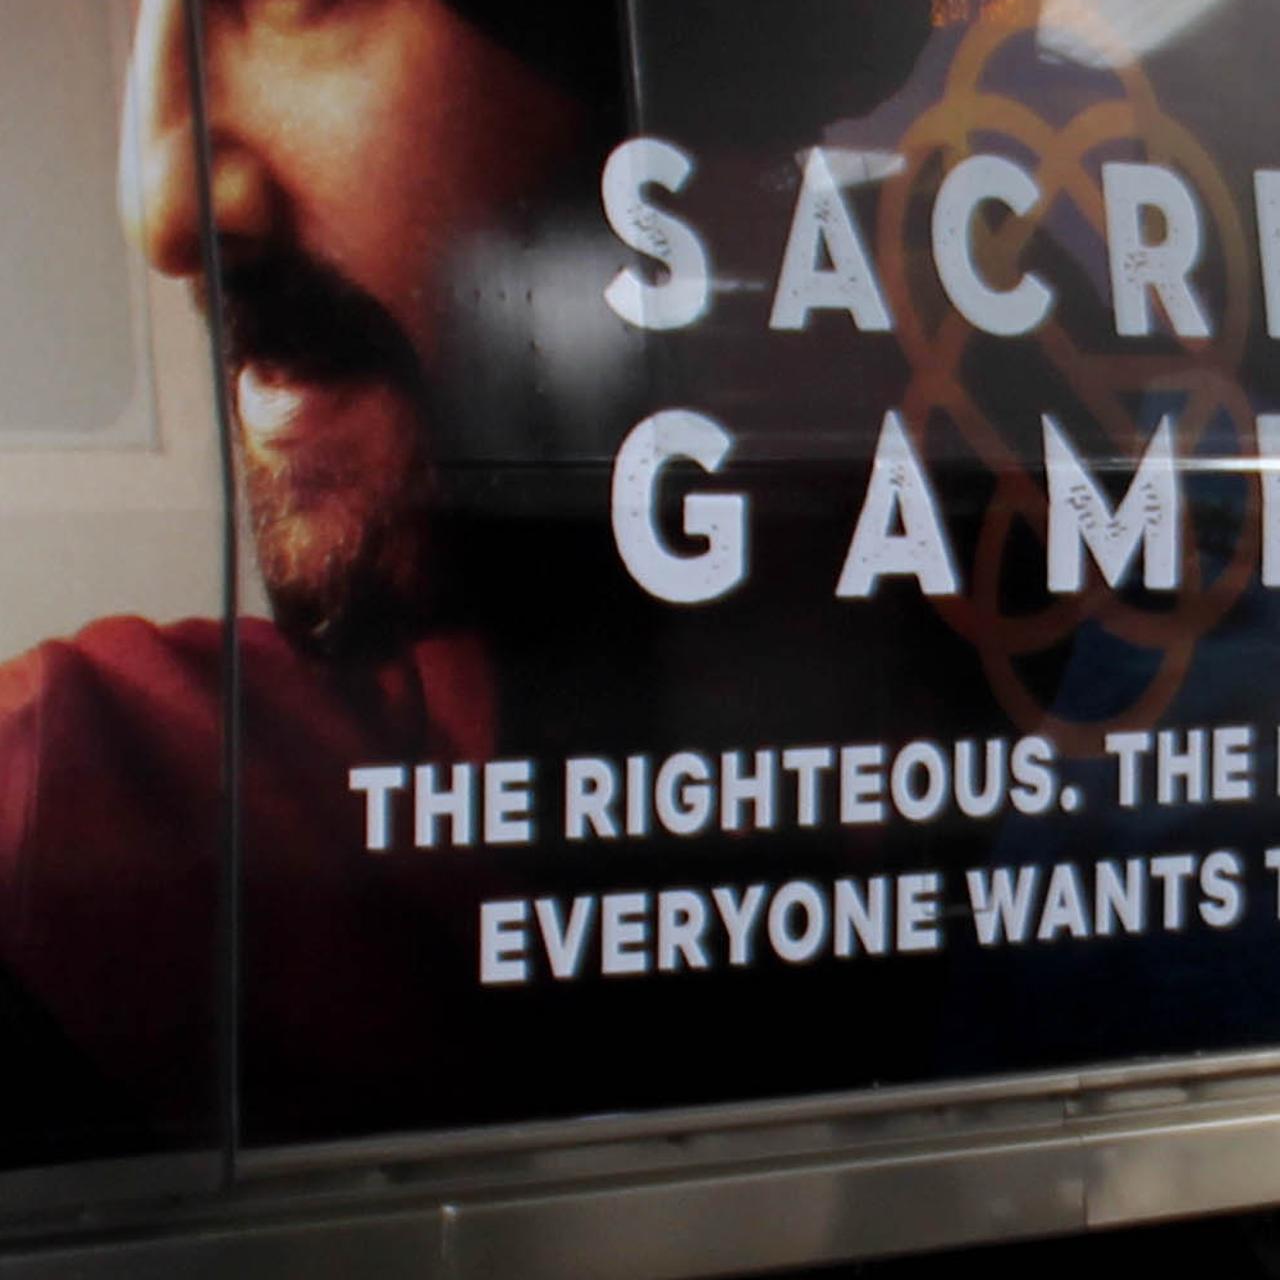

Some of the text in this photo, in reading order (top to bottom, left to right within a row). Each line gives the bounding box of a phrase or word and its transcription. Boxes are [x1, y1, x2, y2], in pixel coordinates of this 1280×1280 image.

[347, 760, 532, 851] THE
[564, 735, 1079, 839] RIGHTEOUS.
[1104, 728, 1252, 807] THE
[480, 873, 940, 984] EVERYONE
[966, 851, 1242, 945] WANTS
